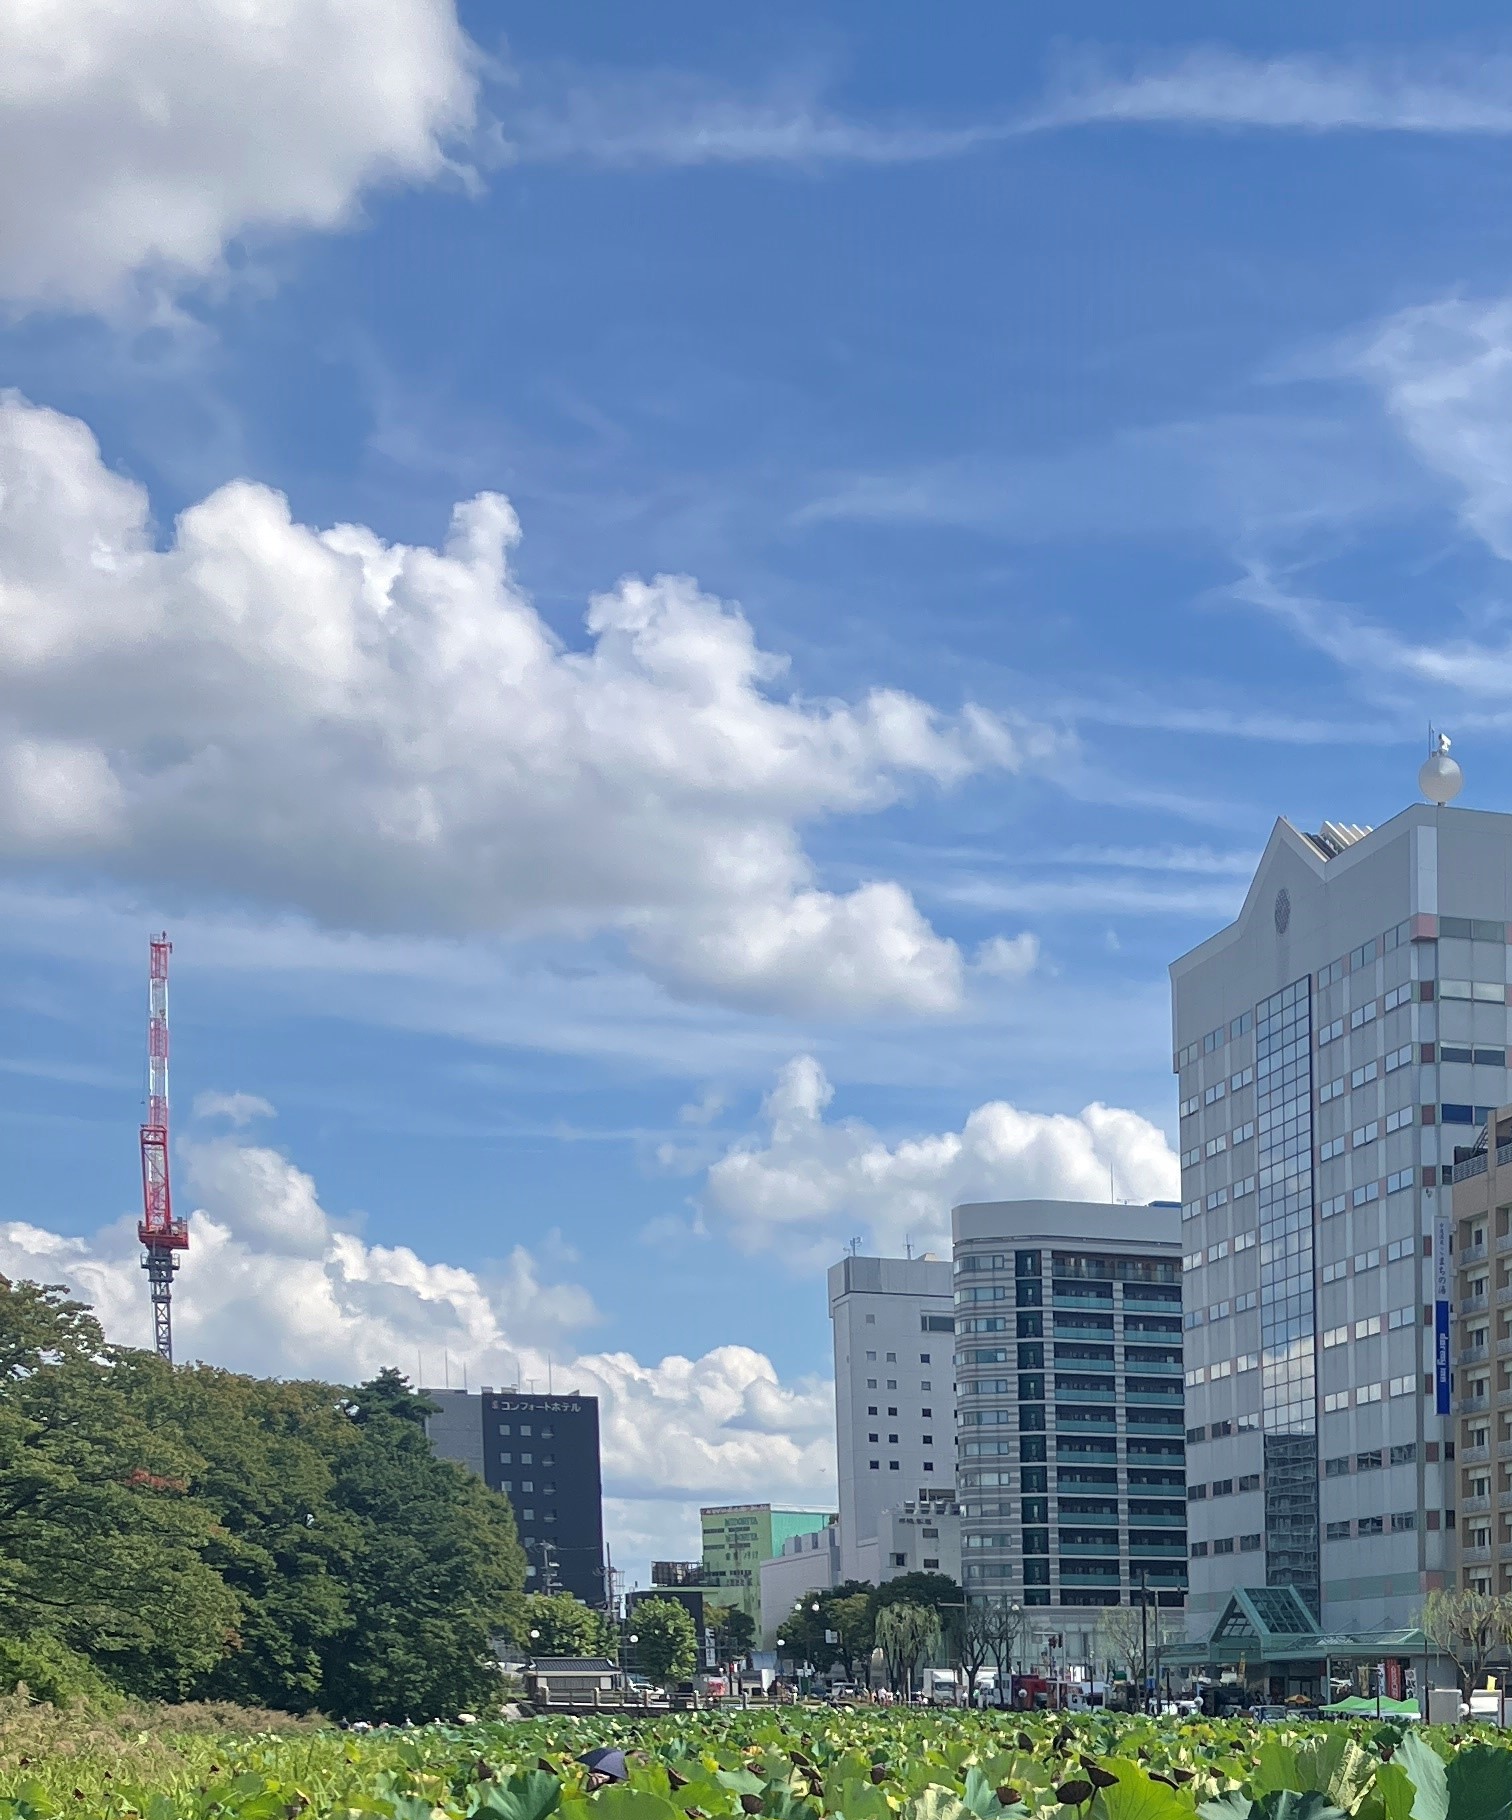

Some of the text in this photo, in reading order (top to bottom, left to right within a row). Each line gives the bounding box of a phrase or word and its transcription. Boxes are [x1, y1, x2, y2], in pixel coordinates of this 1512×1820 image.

[1437, 1333, 1449, 1383] dormy inn
[501, 1401, 581, 1412] コンフォートホテル
